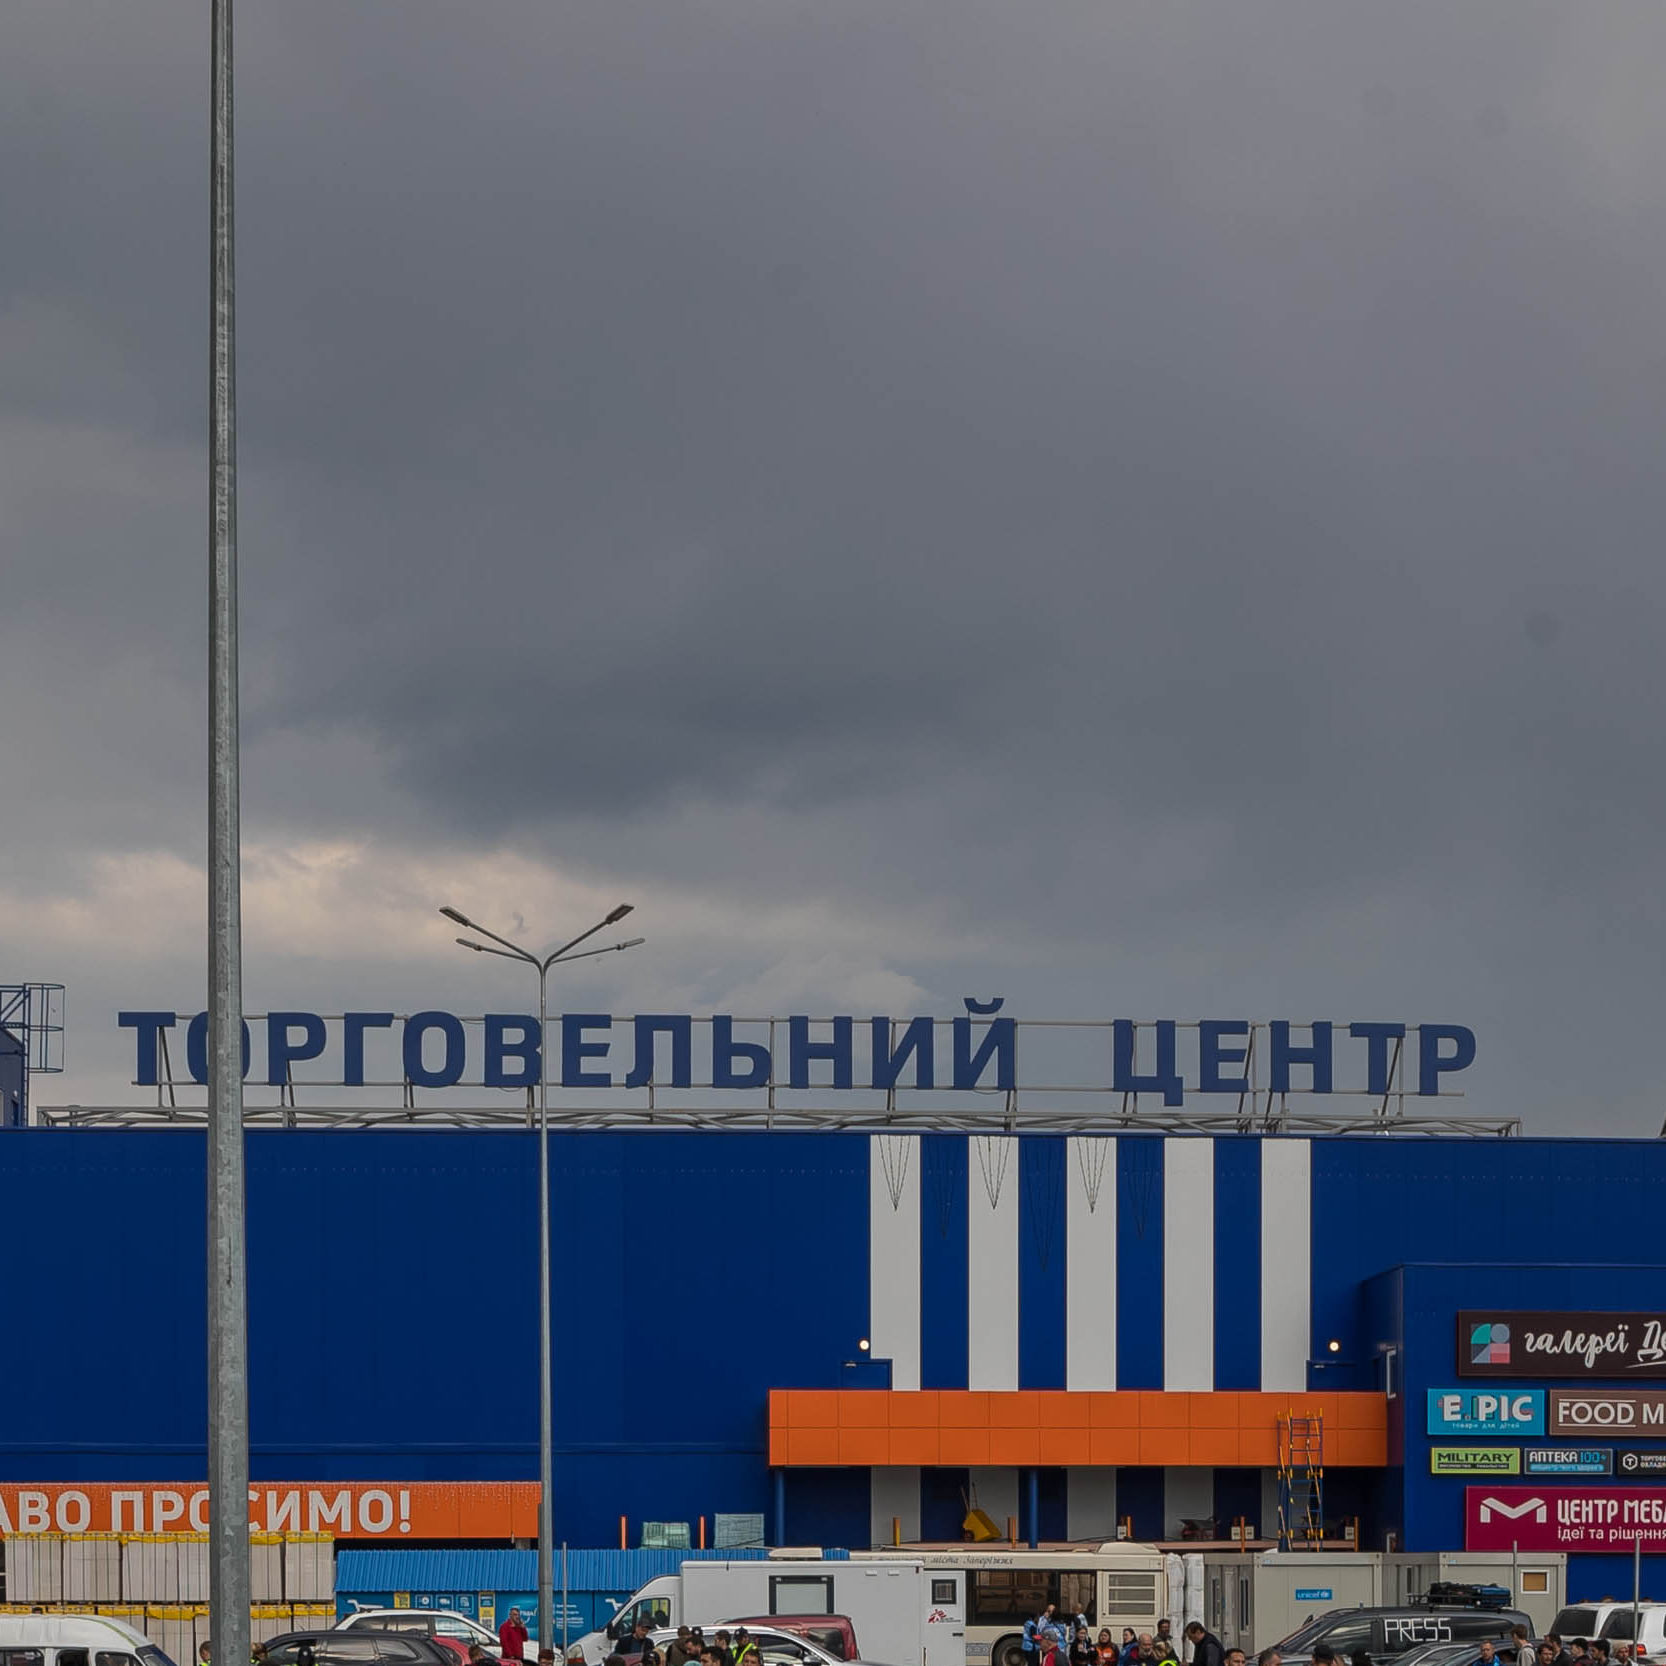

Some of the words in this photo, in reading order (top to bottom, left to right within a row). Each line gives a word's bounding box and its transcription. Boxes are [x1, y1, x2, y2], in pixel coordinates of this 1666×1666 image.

[118, 997, 1016, 1093] ТОРГОВЕЛЬНИЙ
[1111, 1018, 1478, 1106] ЦЕНТР
[1524, 1323, 1630, 1368] галереї
[1558, 1401, 1636, 1425] FOOD
[1437, 1452, 1514, 1463] MILITARY
[1557, 1499, 1619, 1526] ЦЕНТР
[1557, 1526, 1585, 1543] ідеї
[1588, 1529, 1605, 1540] та
[1296, 1590, 1321, 1599] unicef
[1384, 1616, 1452, 1644] PRESS
